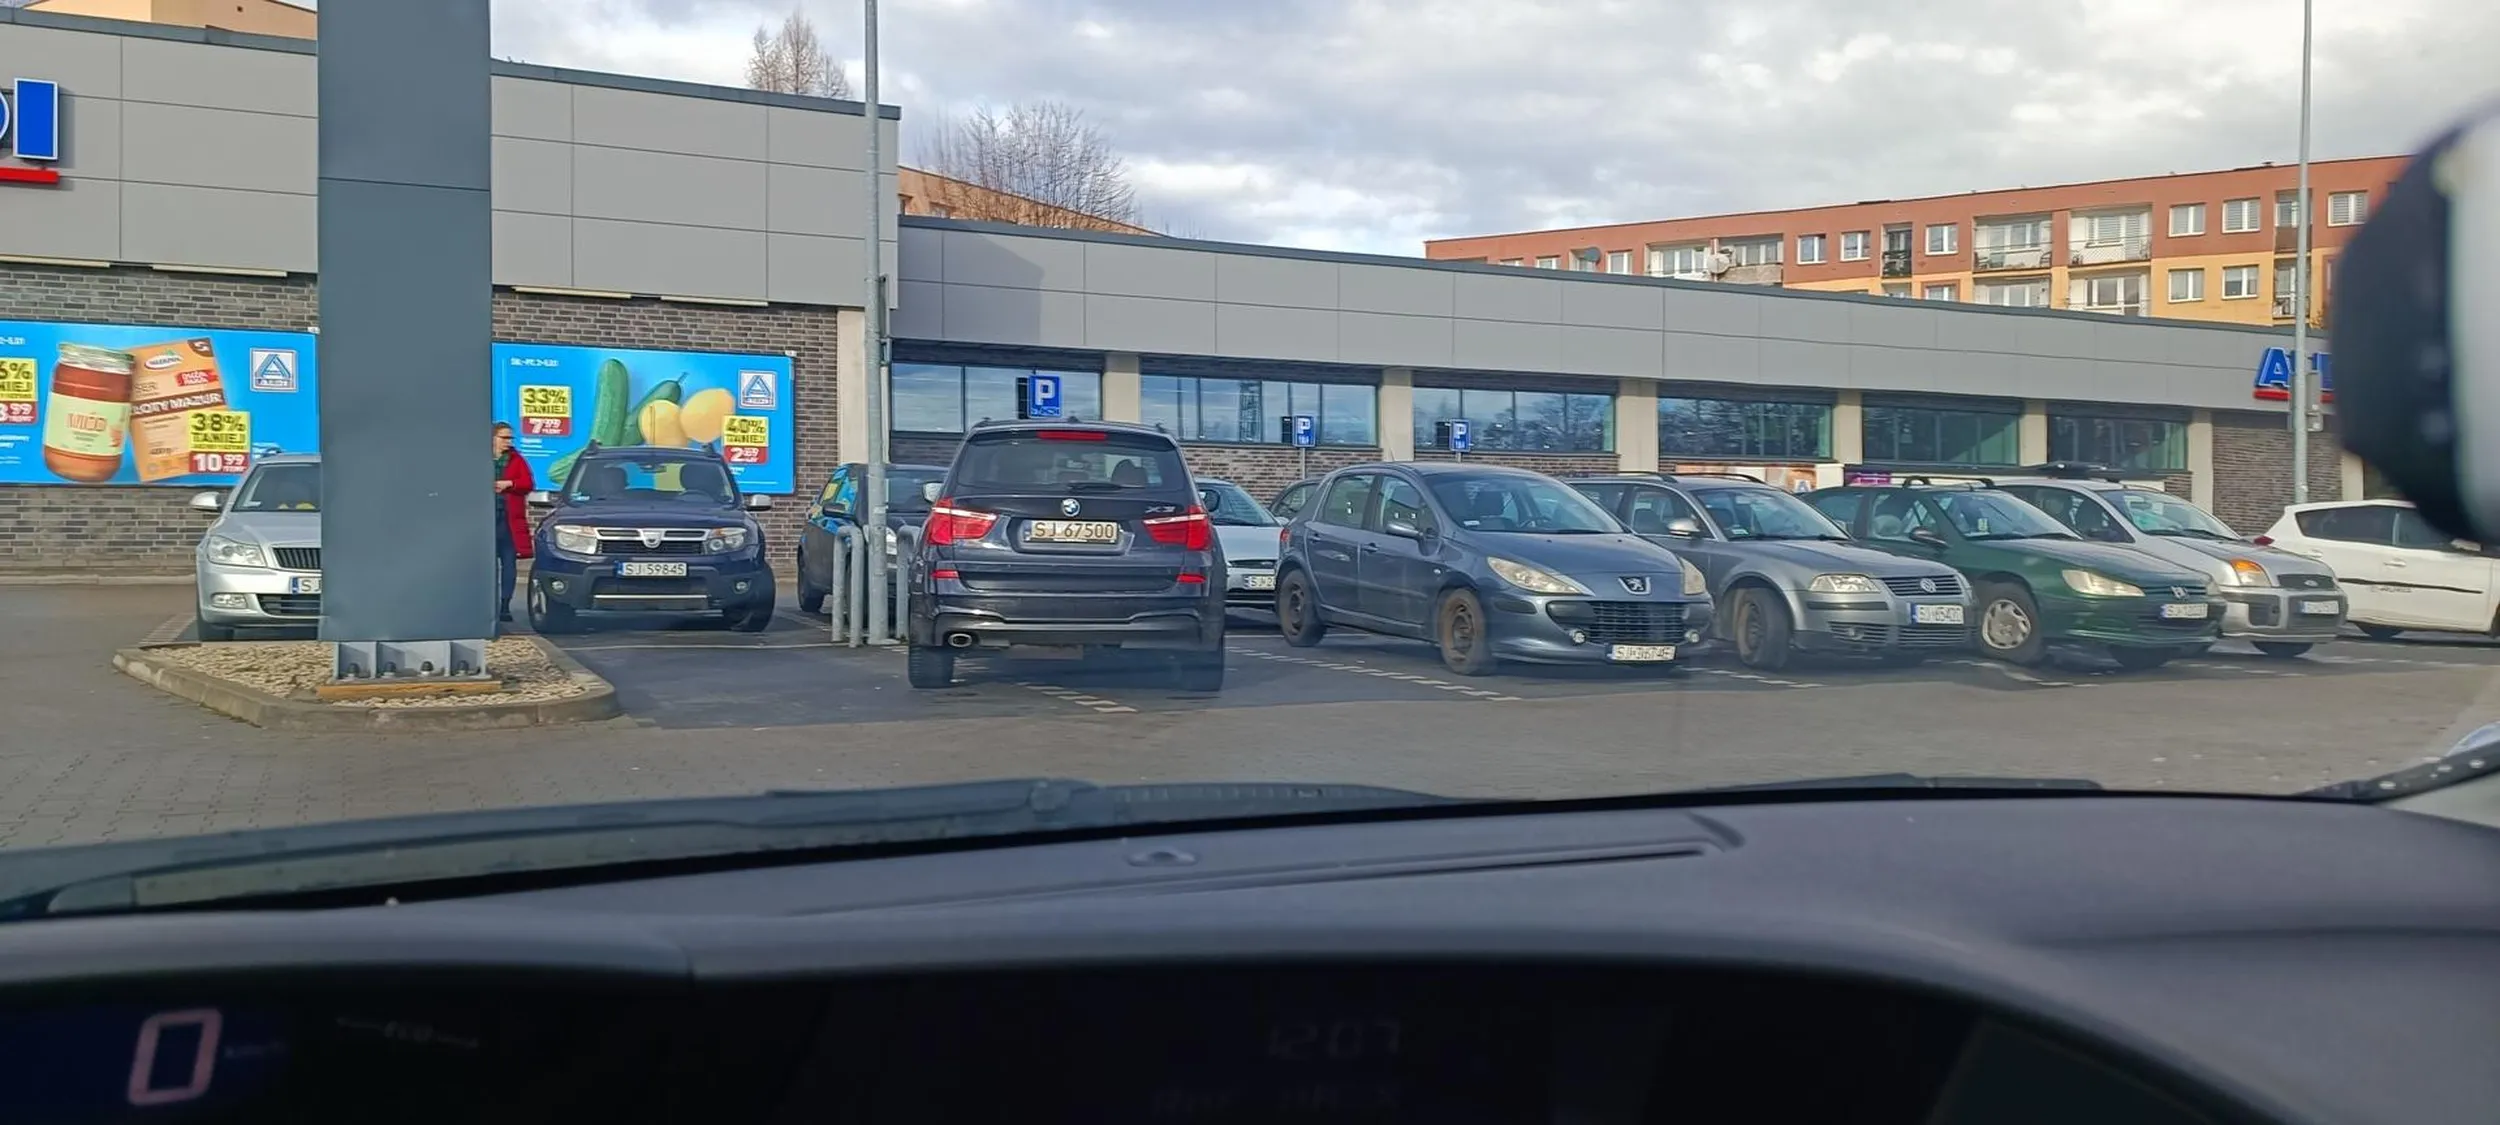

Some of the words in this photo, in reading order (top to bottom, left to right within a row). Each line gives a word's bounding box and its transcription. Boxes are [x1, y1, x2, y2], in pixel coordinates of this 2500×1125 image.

[524, 388, 568, 404] 33%
[1035, 379, 1056, 406] P
[191, 412, 246, 432] 38%
[1297, 417, 1311, 434] P
[191, 432, 246, 444] TANIEJ
[1453, 423, 1467, 439] P
[1034, 521, 1056, 537] SJ
[1064, 523, 1114, 539] 67500
[625, 564, 642, 575] SJ
[648, 564, 685, 576] 59845
[128, 1008, 223, 1106] 0
